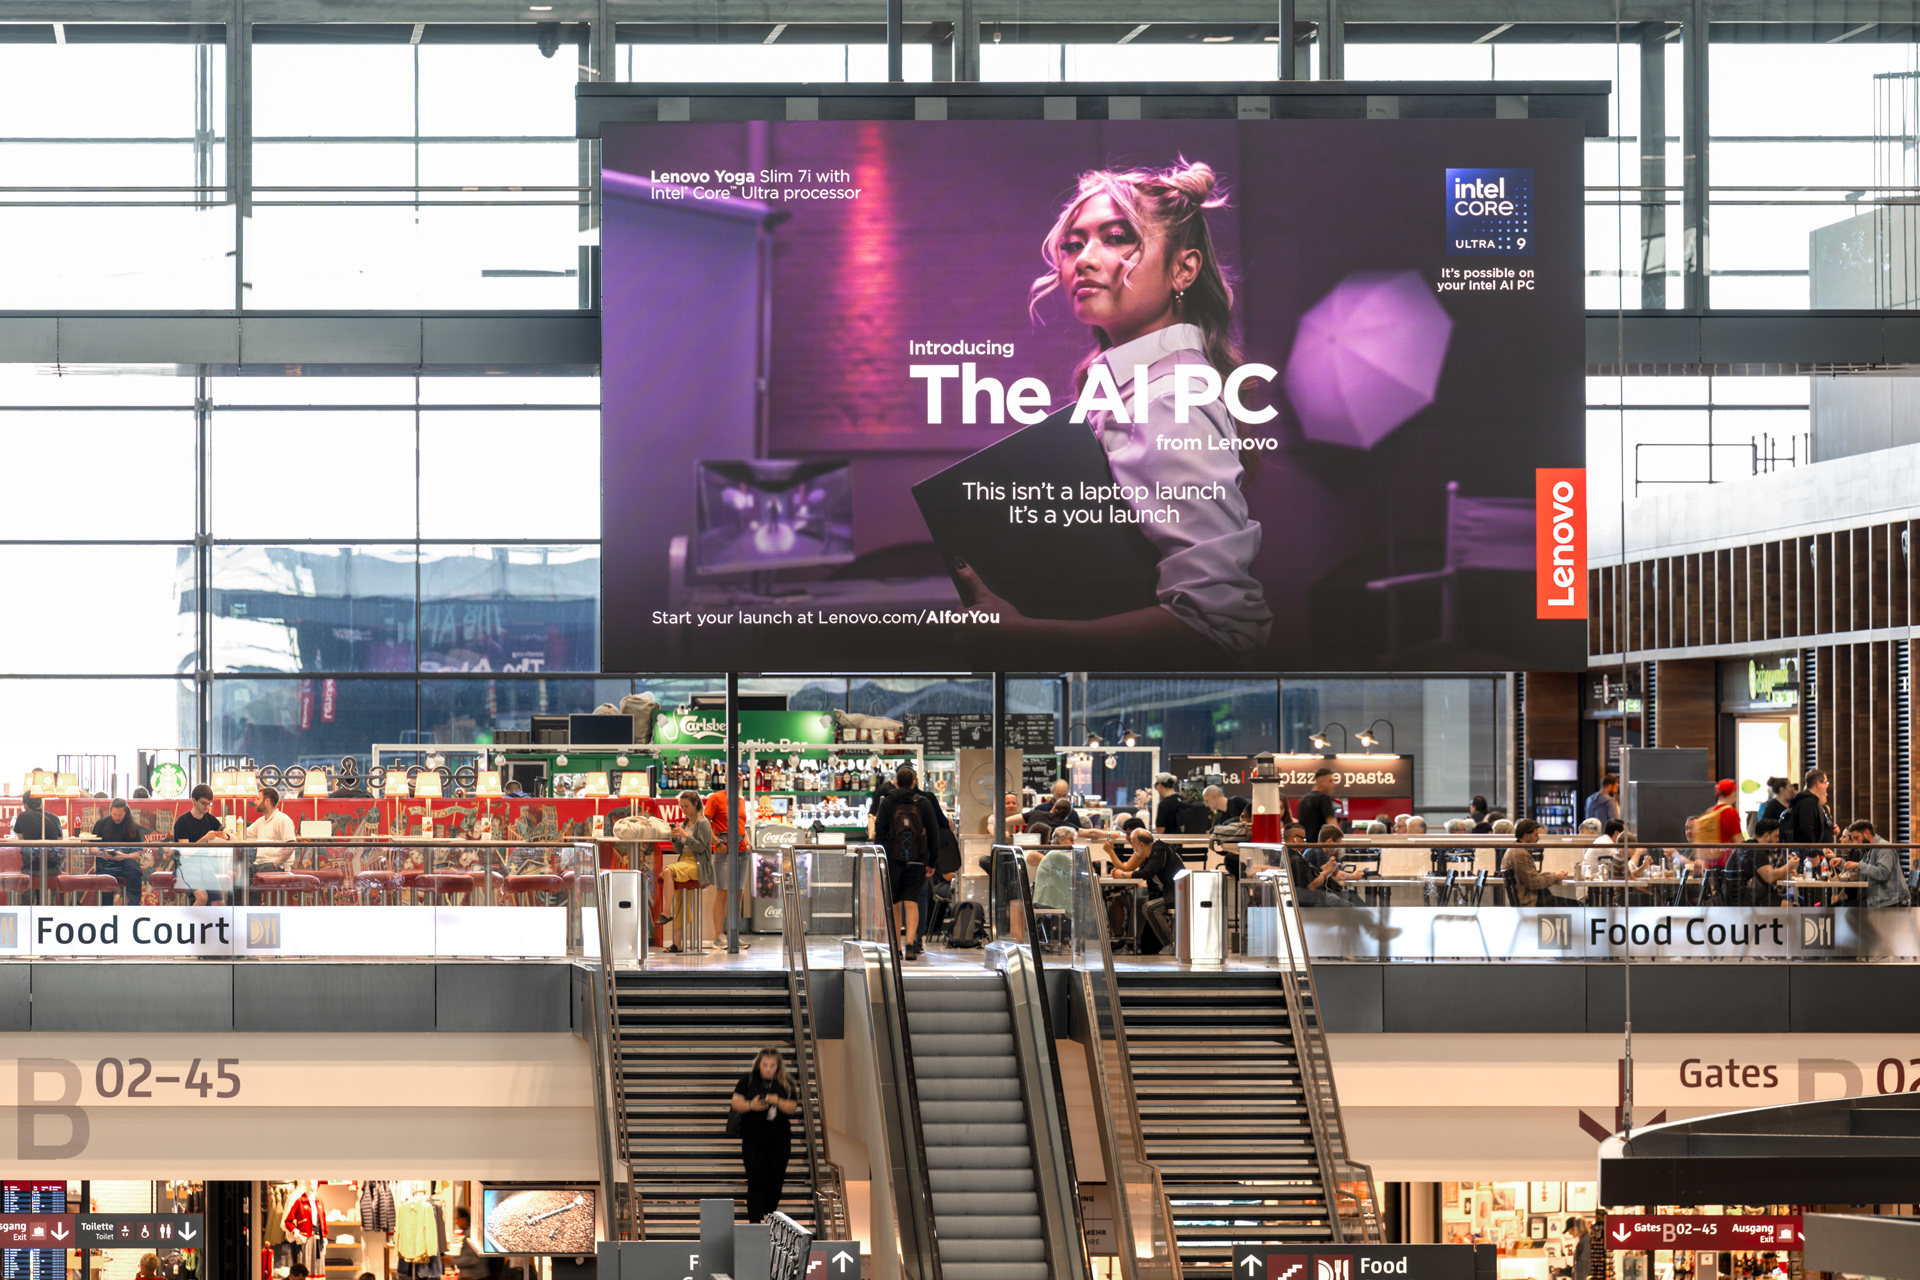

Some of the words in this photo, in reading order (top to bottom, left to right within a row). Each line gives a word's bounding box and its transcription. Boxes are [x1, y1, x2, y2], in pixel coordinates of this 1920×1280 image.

[650, 169, 710, 183] Lenovo
[714, 169, 755, 185] Yoga
[760, 169, 793, 183] Slim
[798, 169, 811, 183] 7i
[816, 169, 850, 183] with
[741, 185, 779, 200] Ultra
[784, 188, 862, 202] processor
[1455, 177, 1505, 199] intel
[1455, 239, 1496, 249] ULTRA
[1516, 237, 1527, 250] 9
[1441, 267, 1461, 278] It's
[1464, 267, 1516, 281] possible
[1518, 269, 1535, 278] on
[1437, 282, 1466, 293] your
[1468, 279, 1496, 291] Intel
[1499, 279, 1514, 291] AI
[1517, 279, 1535, 291] PC
[909, 339, 1014, 358] Introducing
[909, 362, 1051, 425] The
[1069, 363, 1148, 424] AI
[1174, 362, 1279, 425] PC
[1156, 433, 1202, 451] from
[1207, 434, 1278, 451] Lenovo
[962, 481, 1006, 500] This
[1012, 482, 1055, 500] isn't
[1061, 486, 1073, 500] a
[1081, 481, 1149, 504] laptop
[1156, 481, 1226, 500] launch
[1009, 505, 1038, 524] It's
[1044, 509, 1056, 524] a
[1063, 509, 1102, 528] you
[1110, 505, 1180, 524] launch
[1547, 480, 1575, 607] Lenovo
[652, 610, 692, 625] Start
[697, 613, 734, 627] your
[739, 610, 793, 625] launch
[797, 611, 814, 625] at
[818, 609, 1001, 627] Lenovo.com/AIforYou
[680, 715, 742, 736] Carlsbe
[1278, 770, 1316, 787] pizz
[1344, 770, 1396, 788] pasta
[36, 914, 119, 945] Food
[132, 915, 231, 946] Court
[1590, 915, 1673, 946] Food
[1685, 916, 1785, 946] Court
[1679, 1058, 1779, 1088] Gates
[17, 1057, 91, 1161] B
[81, 1222, 114, 1231] Toilette
[1634, 1222, 1662, 1232] Gates
[1662, 1223, 1677, 1243] B
[1731, 1223, 1774, 1235] Ausgang
[13, 1233, 27, 1241] Exit
[95, 1233, 114, 1241] Toilet
[1759, 1235, 1775, 1244] Exit
[1360, 1256, 1408, 1274] Food
